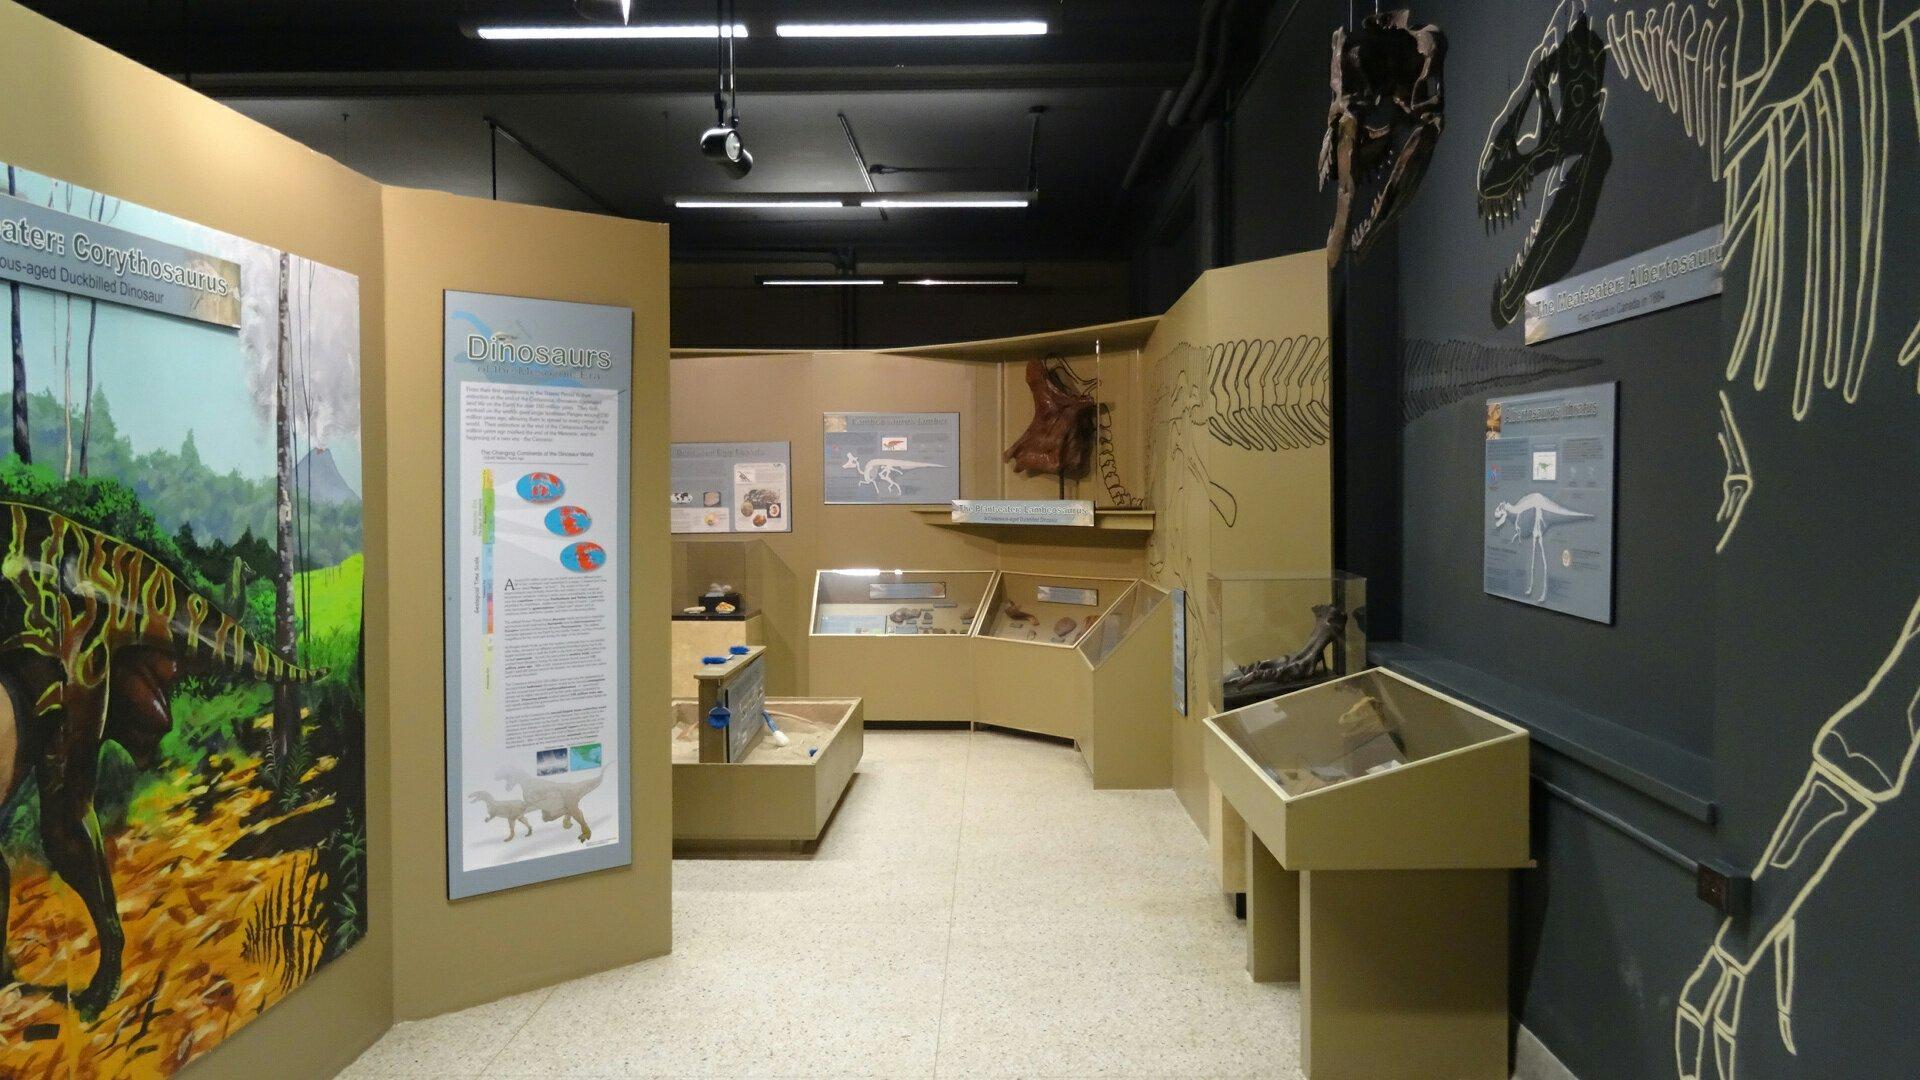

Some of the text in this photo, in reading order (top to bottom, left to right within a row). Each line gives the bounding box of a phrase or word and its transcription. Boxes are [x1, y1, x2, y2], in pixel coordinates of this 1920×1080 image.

[0, 217, 228, 296] ater: Corythosaurus
[60, 267, 117, 294] Duckbilled
[120, 282, 165, 304] Dinosaur
[1535, 299, 1554, 320] The
[467, 334, 612, 370] Dinosaurs
